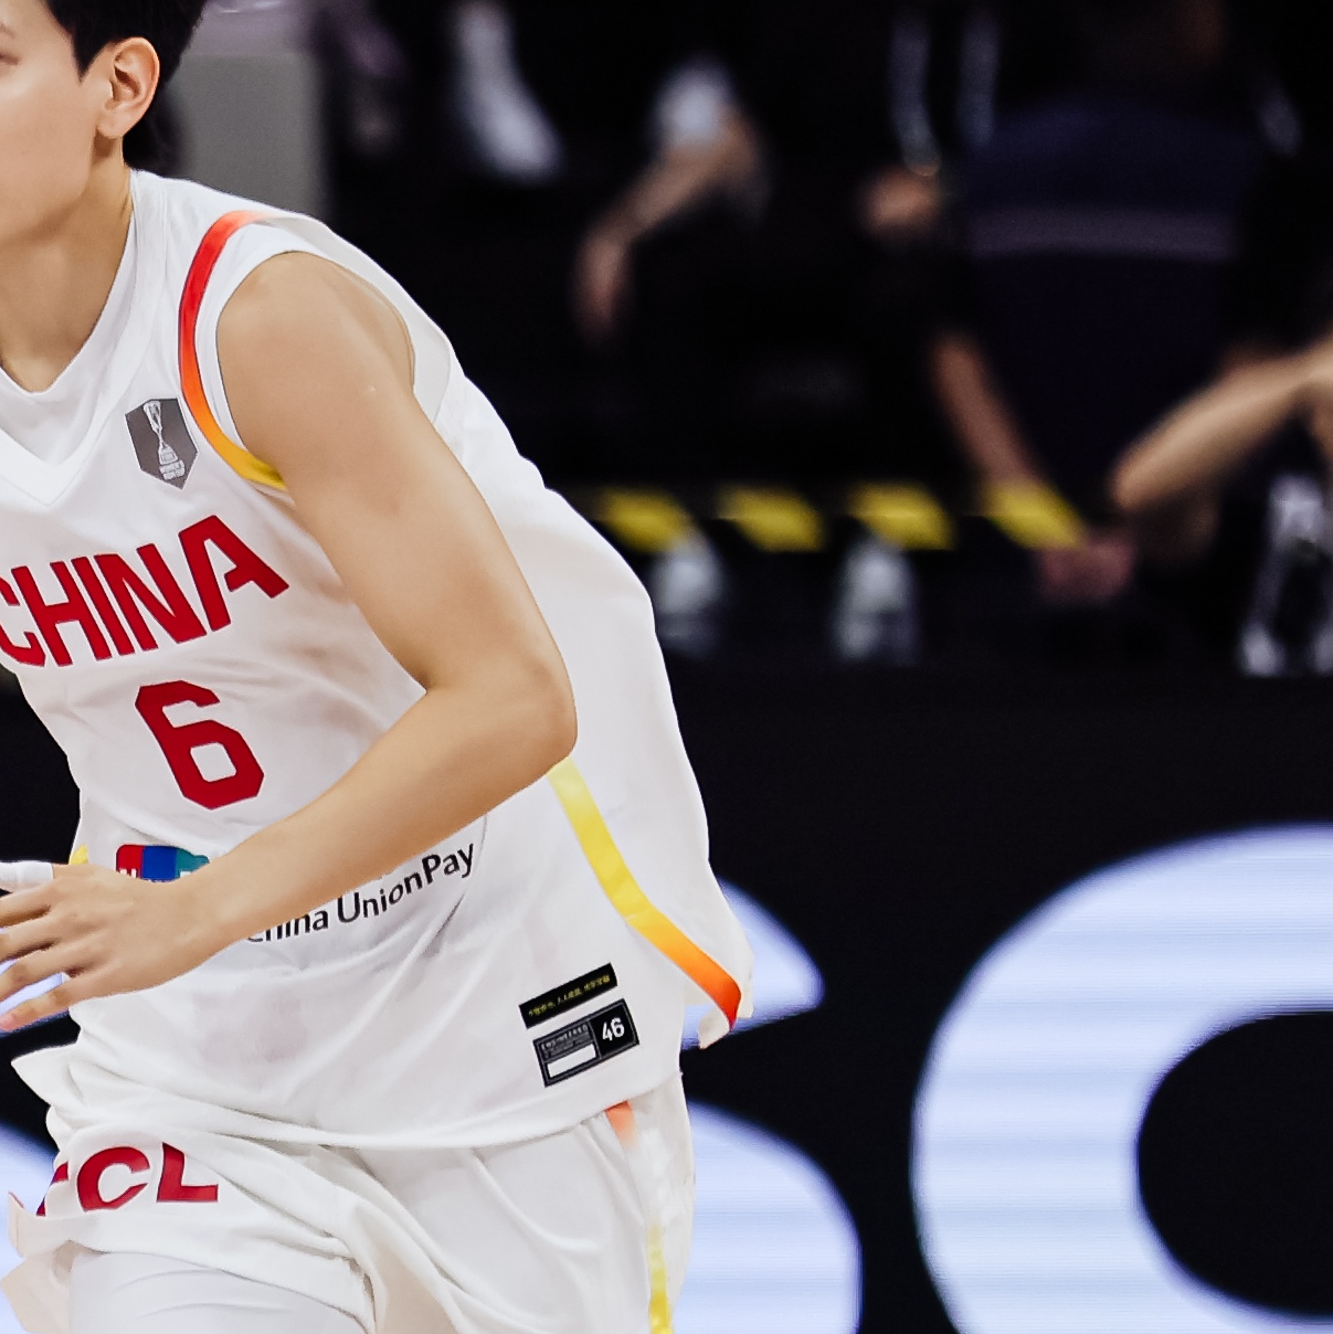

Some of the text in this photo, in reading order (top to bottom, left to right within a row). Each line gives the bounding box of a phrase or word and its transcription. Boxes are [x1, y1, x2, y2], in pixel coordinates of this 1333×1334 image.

[134, 680, 265, 811] 6
[336, 842, 475, 924] UnionPay
[602, 1017, 625, 1042] 46
